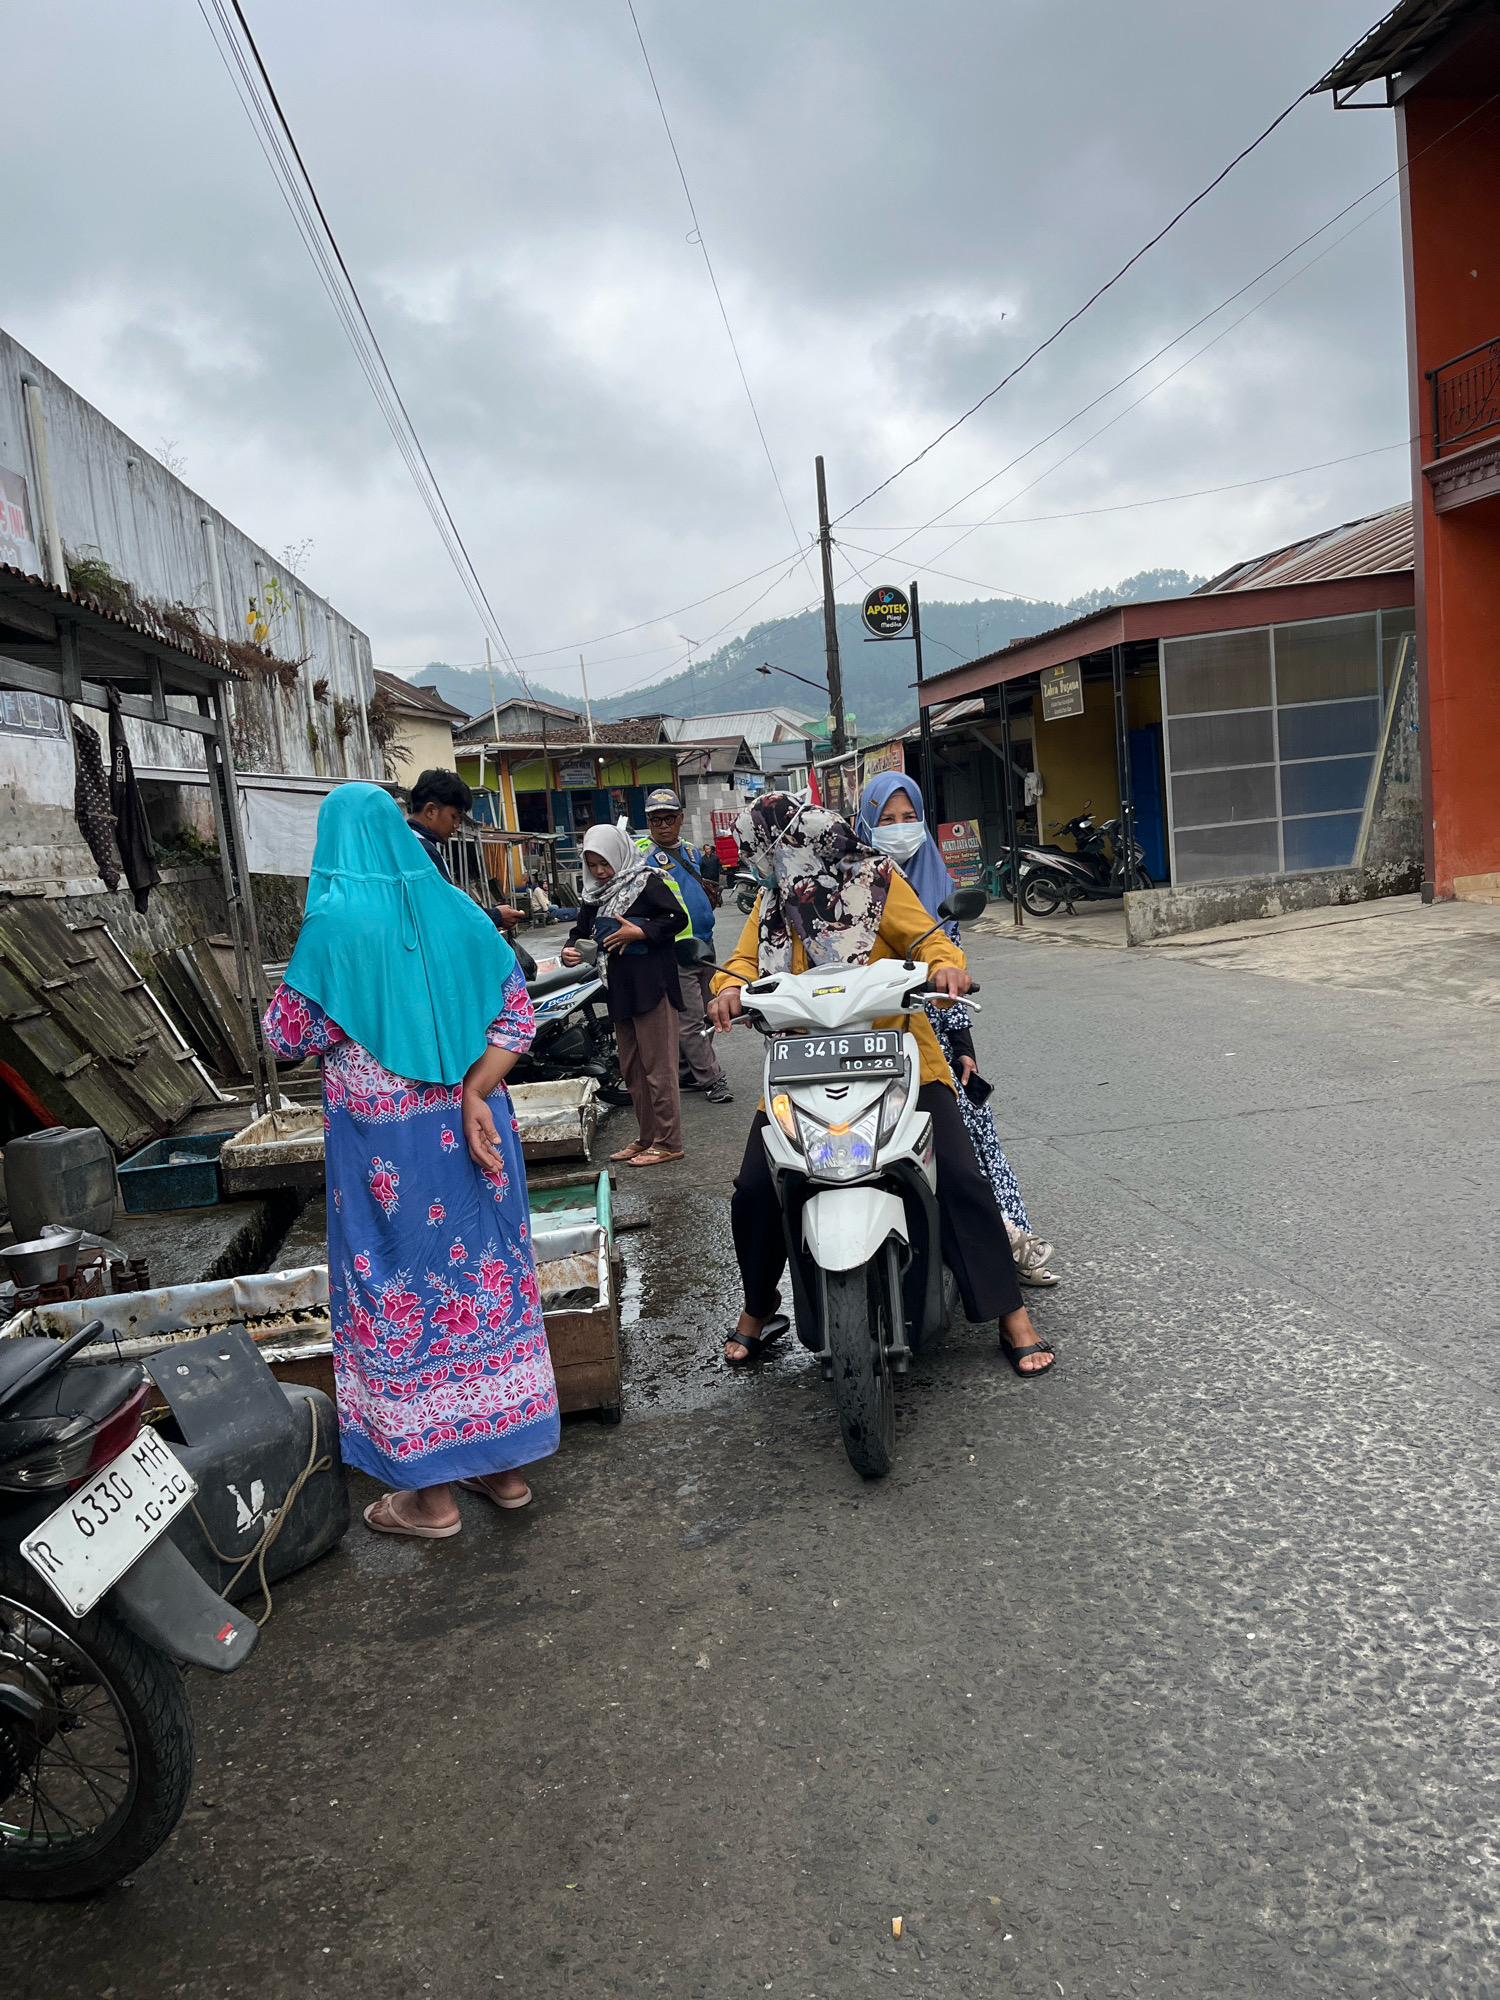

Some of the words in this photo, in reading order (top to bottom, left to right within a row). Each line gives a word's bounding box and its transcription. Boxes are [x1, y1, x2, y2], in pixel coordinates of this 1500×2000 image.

[867, 603, 907, 615] APOTEK
[778, 1044, 789, 1060] R
[804, 1039, 849, 1058] 3416
[863, 1036, 887, 1053] BD
[34, 1541, 64, 1573] R
[71, 1471, 134, 1538] 6330
[131, 1435, 169, 1478] MH
